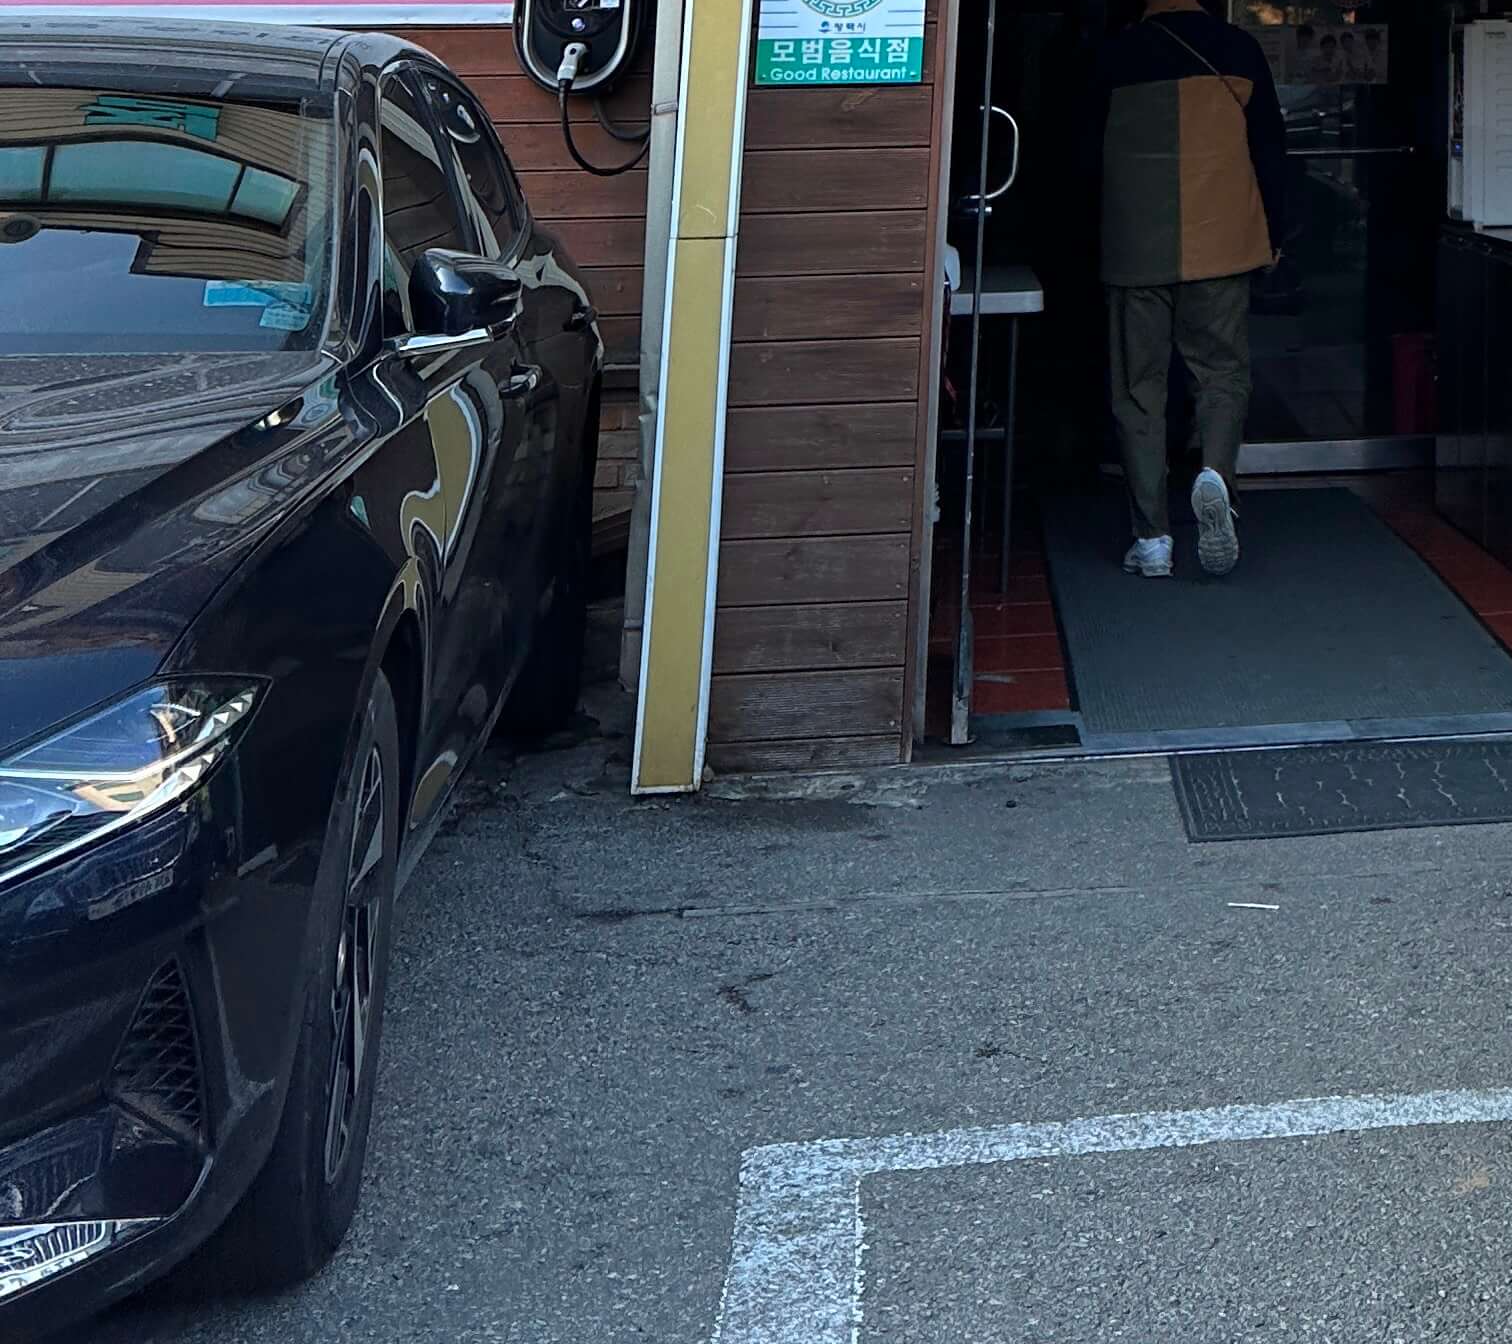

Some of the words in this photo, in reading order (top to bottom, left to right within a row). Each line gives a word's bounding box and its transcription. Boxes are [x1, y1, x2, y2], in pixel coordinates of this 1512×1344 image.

[770, 38, 910, 64] 모범음식점
[770, 68, 817, 81] Good
[821, 66, 907, 80] Restaurant
